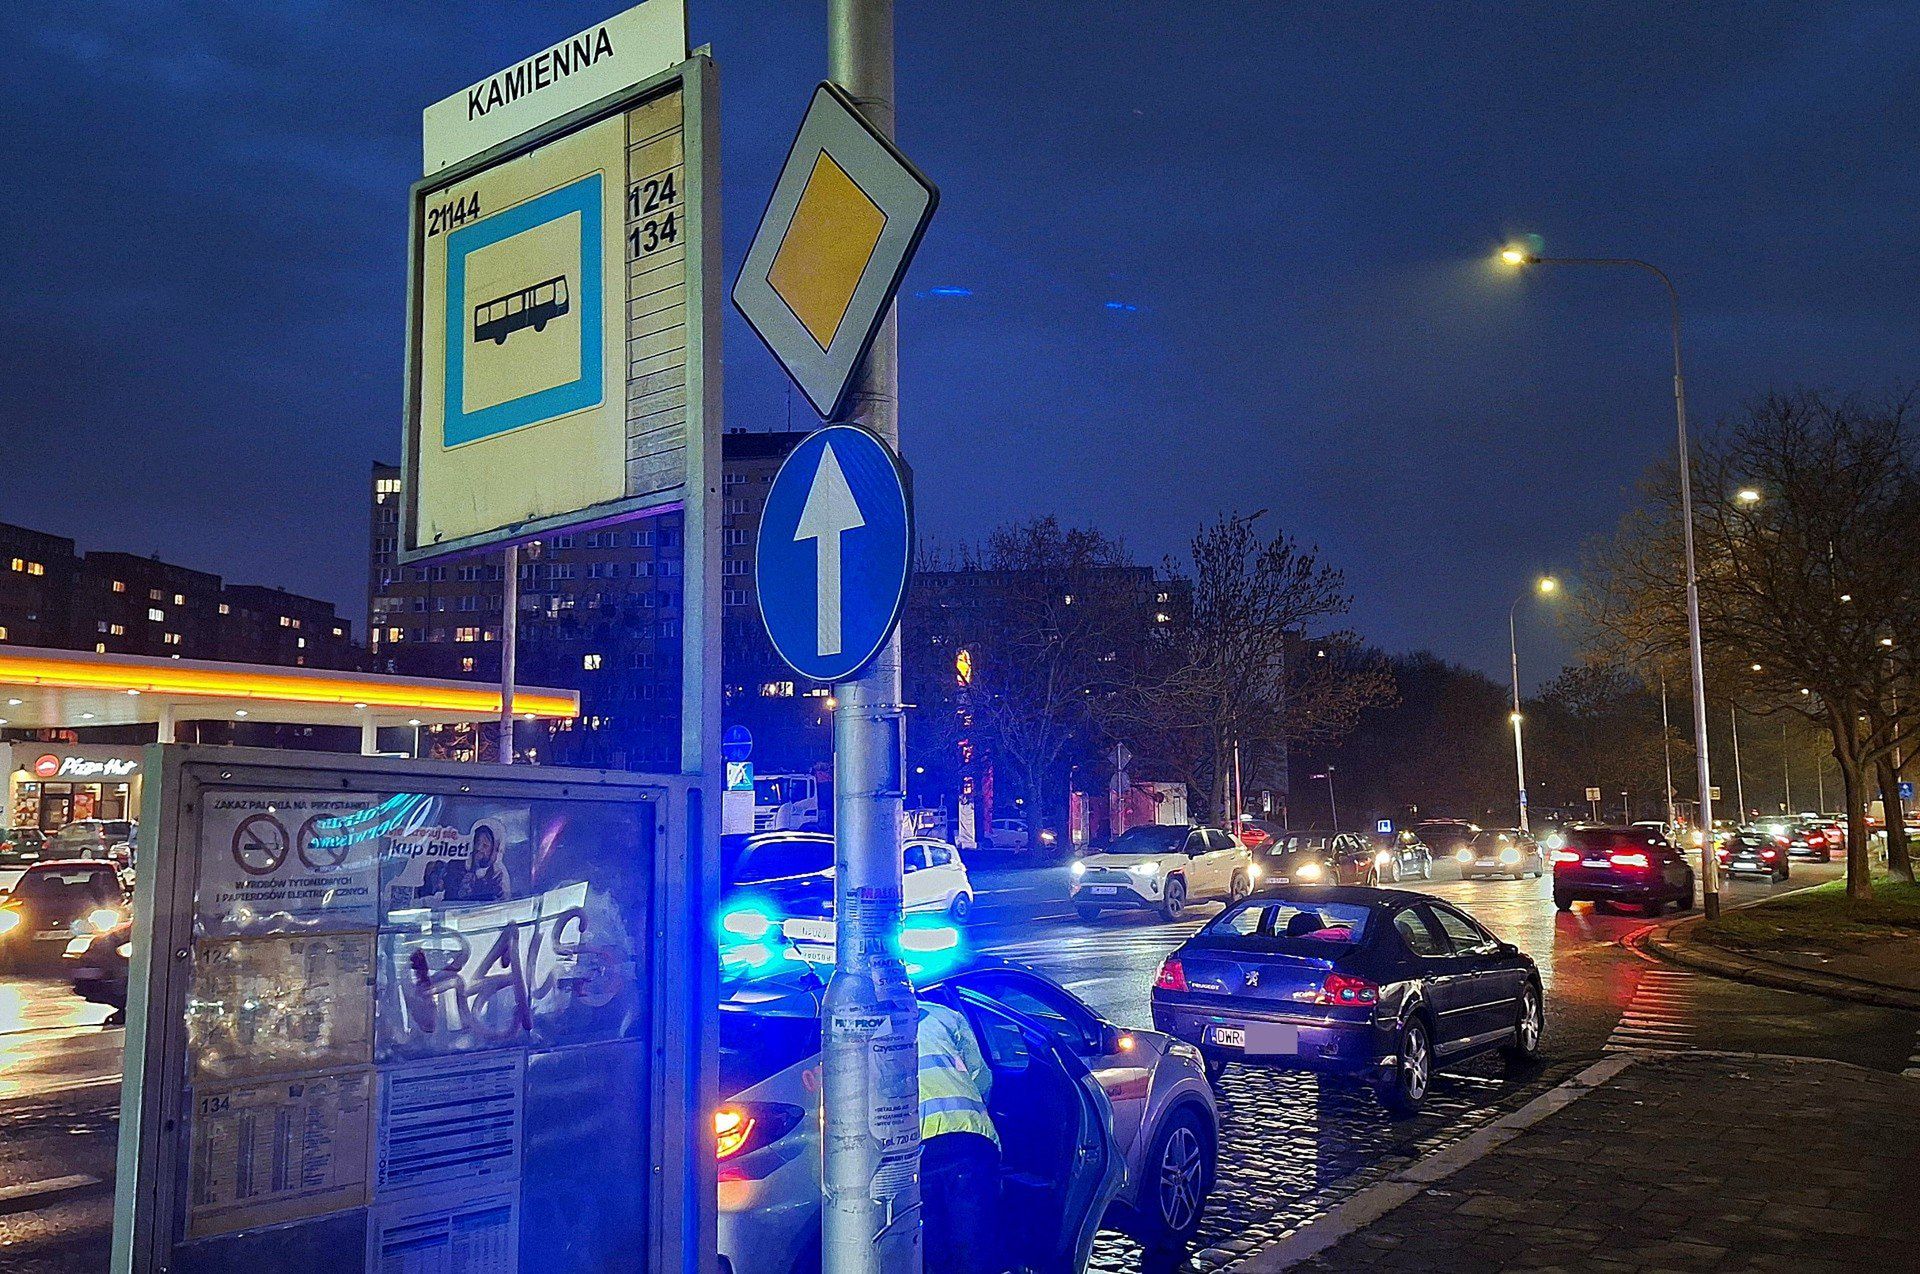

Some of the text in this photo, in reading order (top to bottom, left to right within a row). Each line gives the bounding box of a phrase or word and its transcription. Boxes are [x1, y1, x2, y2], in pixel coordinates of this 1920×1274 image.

[467, 27, 614, 121] KAMIENNA
[628, 173, 676, 217] 124
[428, 191, 480, 237] 21144
[628, 212, 677, 257] 134
[58, 757, 138, 776] Pizza Hut
[214, 800, 247, 810] ZAKAZ
[391, 838, 469, 859] kup bilet!
[288, 886, 369, 899] ELEKTROCZNYCH
[1217, 1030, 1240, 1044] DWR
[202, 1095, 230, 1114] 134
